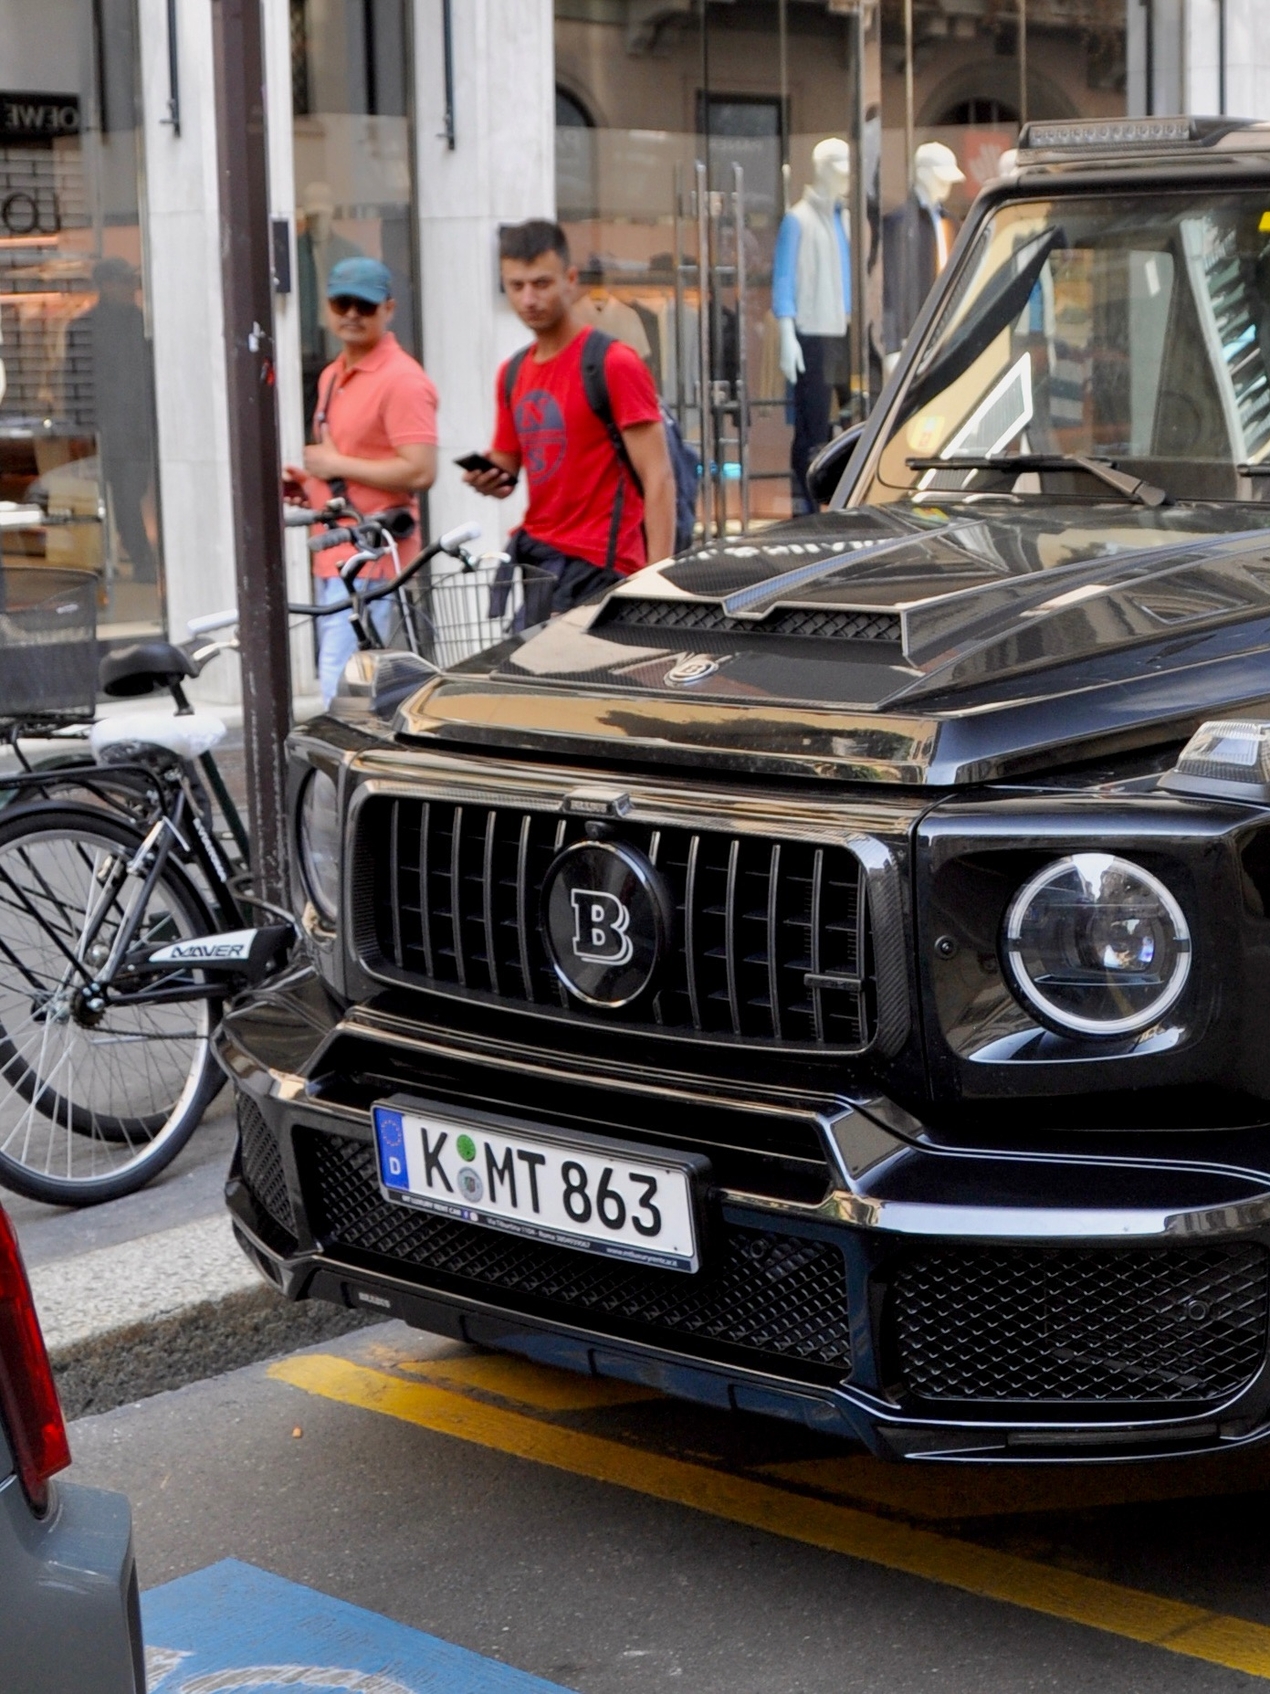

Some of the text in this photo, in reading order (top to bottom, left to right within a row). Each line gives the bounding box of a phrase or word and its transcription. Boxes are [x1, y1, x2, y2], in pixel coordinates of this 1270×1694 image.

[171, 944, 245, 958] MAVER
[571, 888, 633, 966] B
[389, 1156, 401, 1175] D
[421, 1127, 662, 1237] K MT 863
